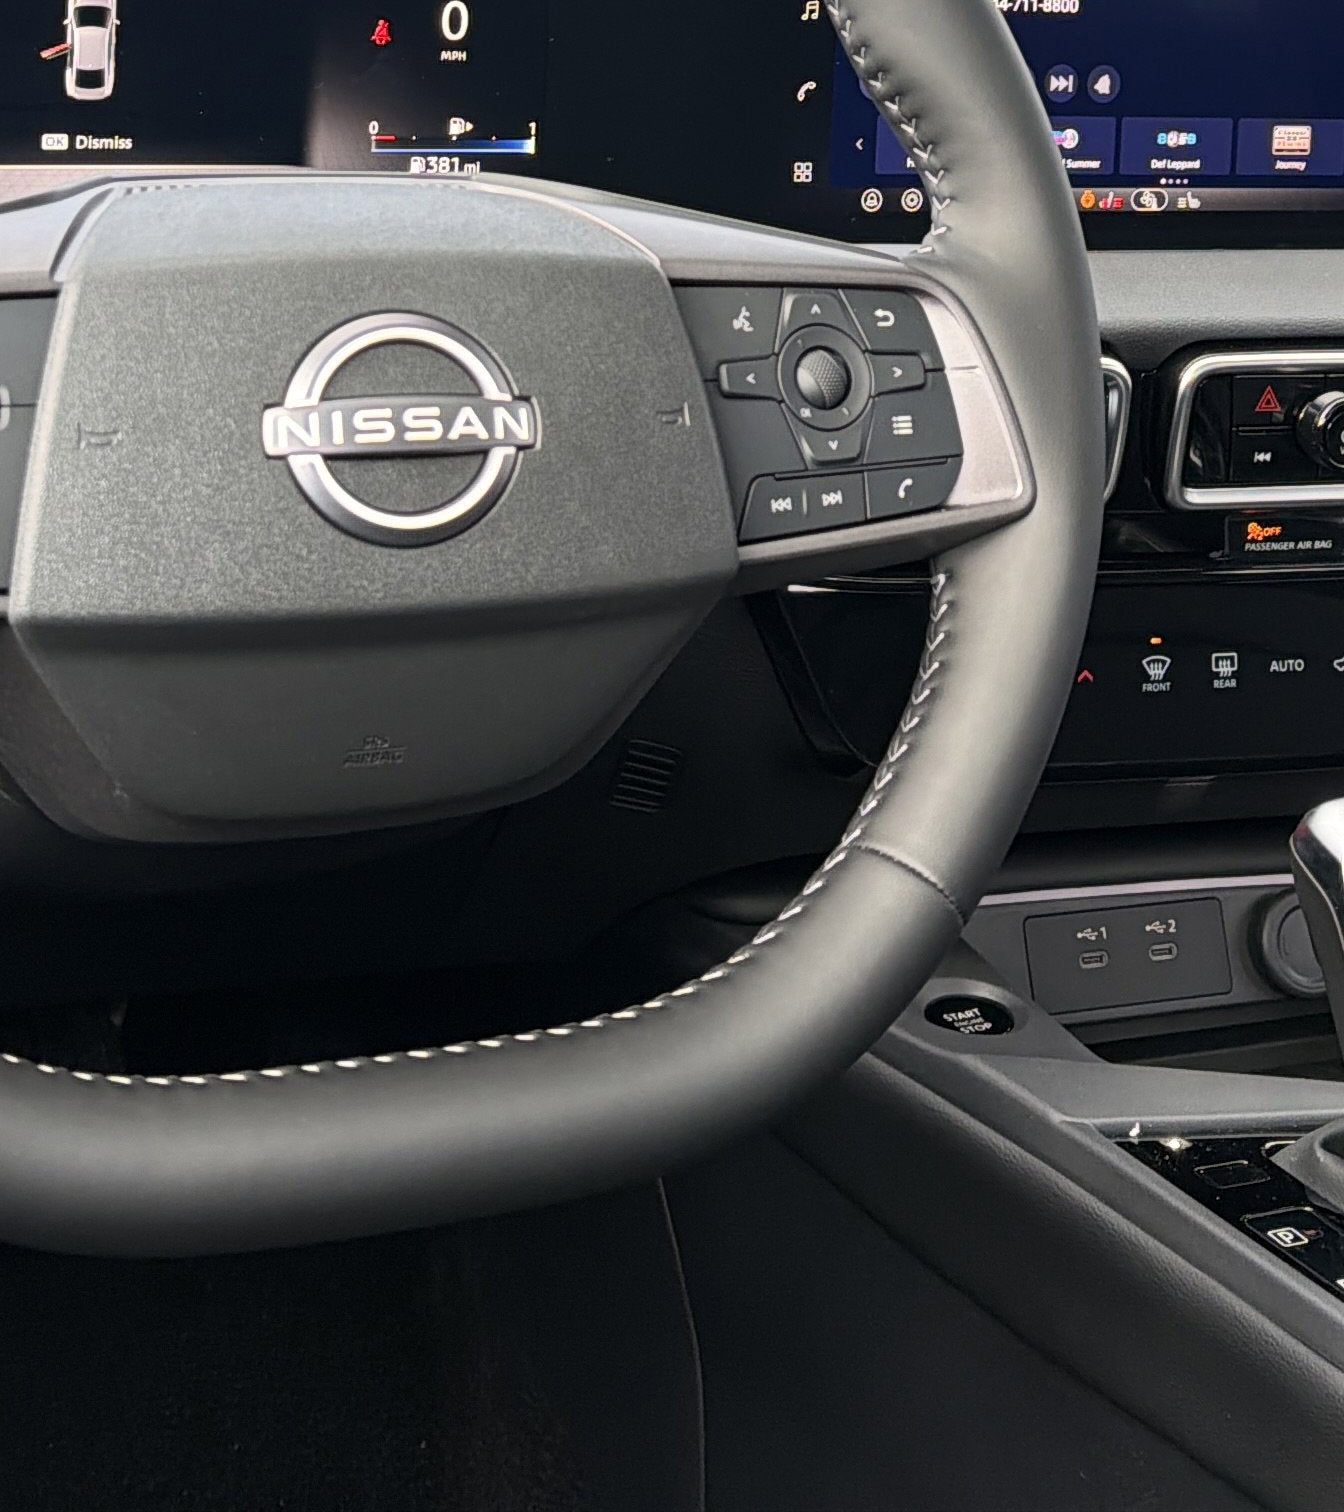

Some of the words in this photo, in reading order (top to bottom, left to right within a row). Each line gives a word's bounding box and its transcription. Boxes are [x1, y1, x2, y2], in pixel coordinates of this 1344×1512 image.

[441, 0, 469, 40] 0
[440, 50, 467, 62] MPH
[369, 121, 379, 135] 0
[529, 122, 537, 135] 1
[45, 136, 64, 147] OK
[76, 135, 133, 150] Dismiss
[426, 157, 460, 174] 381
[464, 161, 480, 175] mi
[1067, 159, 1100, 169] Summer
[1151, 159, 1167, 169] Def
[1167, 159, 1200, 170] Leppard
[1275, 160, 1306, 171] Journey
[276, 407, 531, 449] NISSAN
[1264, 527, 1282, 536] OFF
[1245, 542, 1295, 551] PASSENGER
[1297, 541, 1312, 549] AIR
[1314, 540, 1332, 549] BAG
[1269, 659, 1305, 671] AUTO
[1142, 682, 1171, 693] FRONT
[1213, 678, 1237, 689] REAR
[1167, 920, 1177, 933] 2
[1099, 927, 1107, 940] 1
[943, 1008, 980, 1022] START
[960, 1022, 992, 1033] STOP
[1280, 1231, 1296, 1244] P
